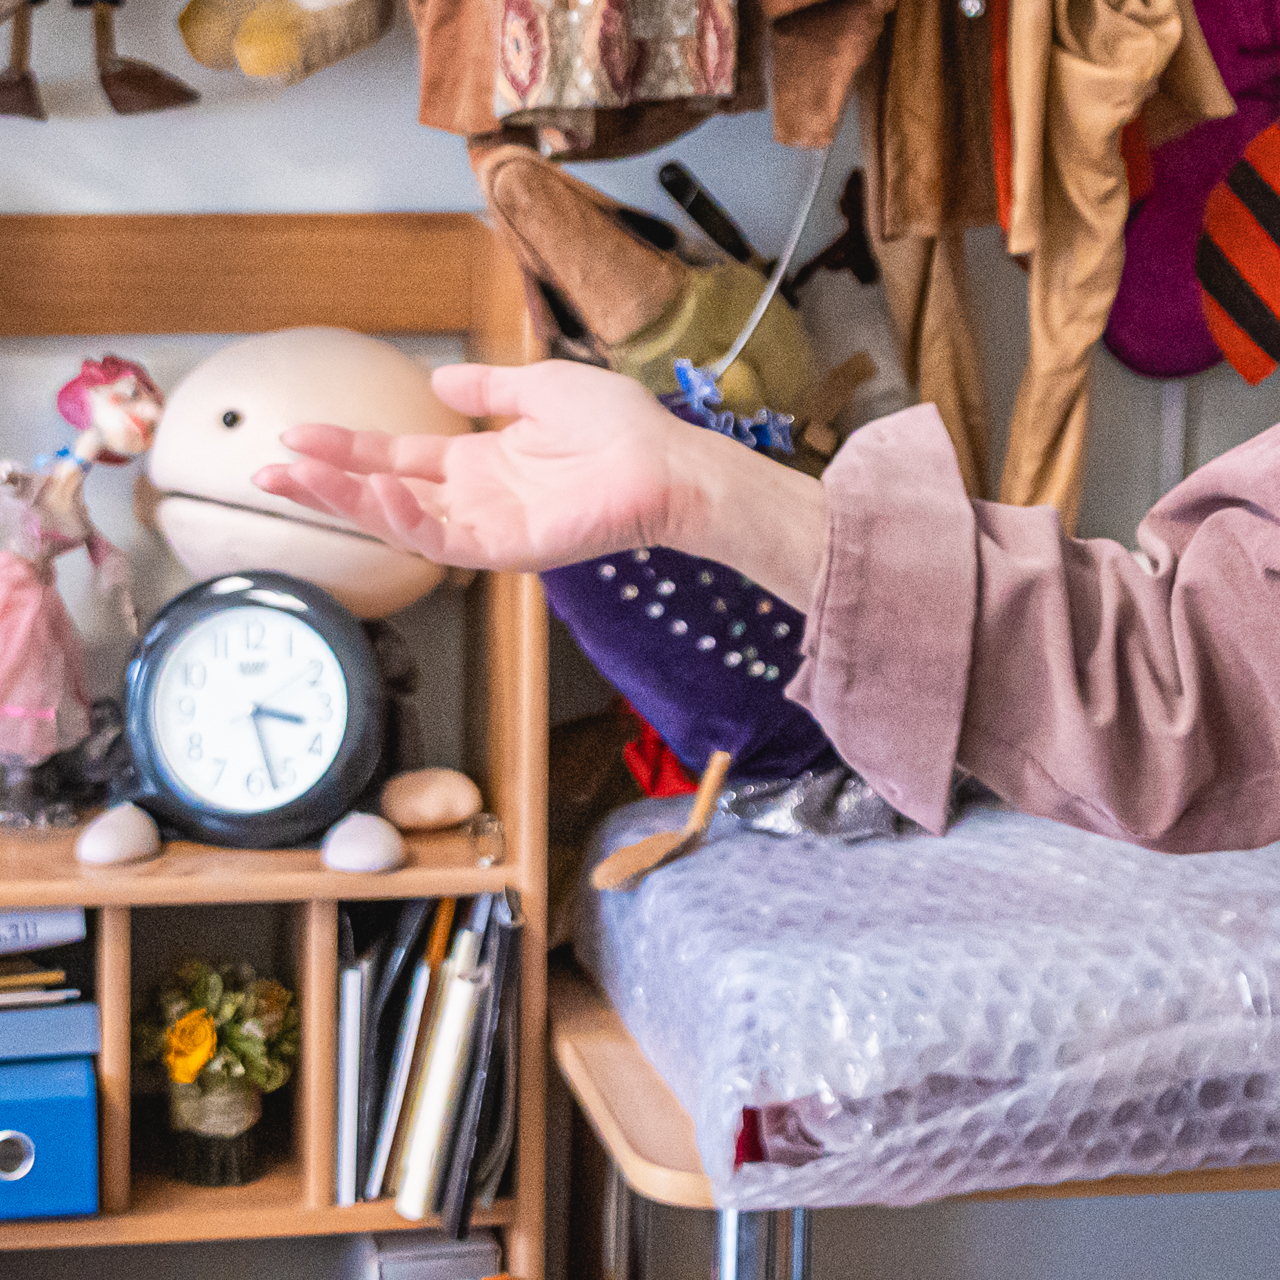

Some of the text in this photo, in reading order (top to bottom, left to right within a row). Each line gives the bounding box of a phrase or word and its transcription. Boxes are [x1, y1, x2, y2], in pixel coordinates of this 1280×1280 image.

[213, 630, 229, 659] 11
[245, 618, 266, 651] 12
[183, 661, 208, 690] 10
[308, 658, 325, 688] 2
[178, 695, 196, 724] 9
[319, 693, 334, 723] 3
[188, 732, 204, 762] 8
[307, 731, 323, 757] 4
[213, 756, 229, 791] 7
[246, 769, 266, 797] 6
